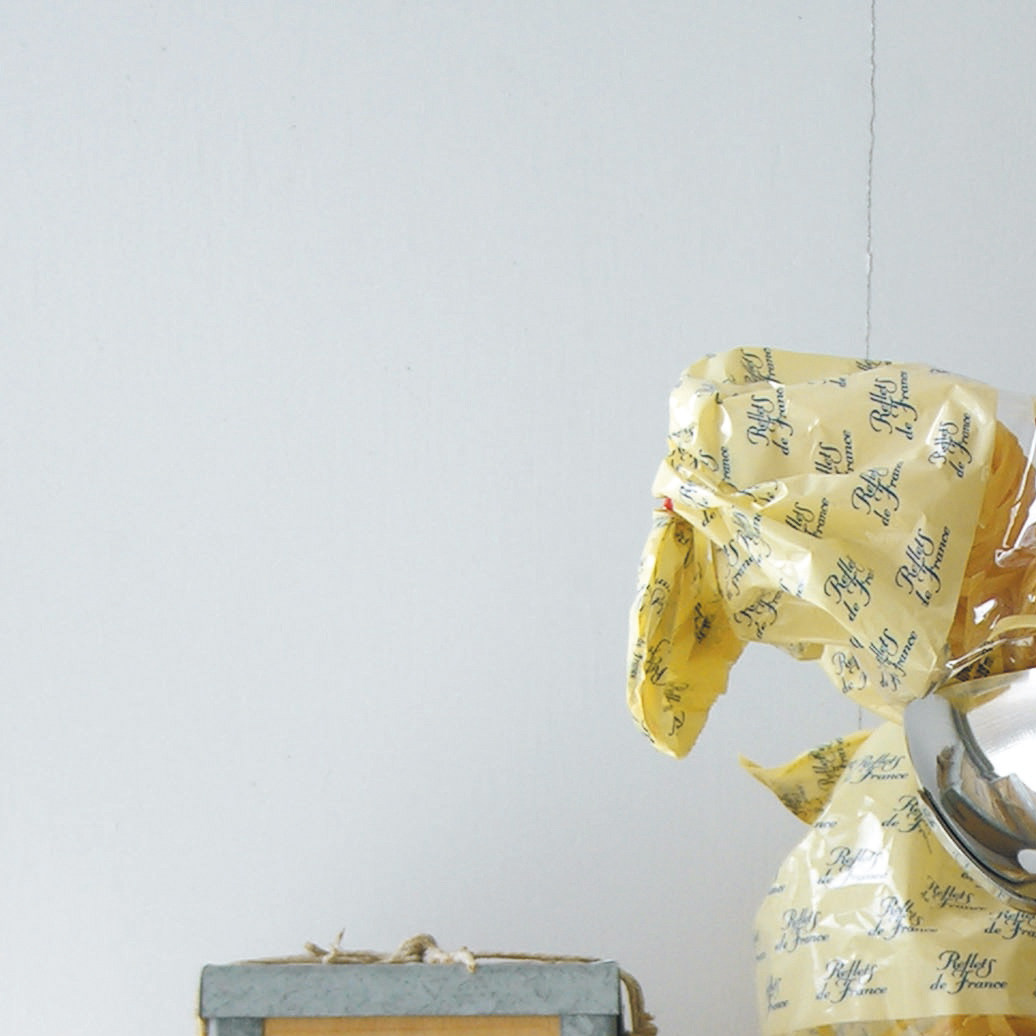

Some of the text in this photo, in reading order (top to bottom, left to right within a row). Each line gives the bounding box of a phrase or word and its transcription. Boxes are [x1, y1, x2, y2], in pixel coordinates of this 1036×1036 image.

[869, 377, 898, 434] Reflets
[895, 422, 914, 440] de
[771, 437, 790, 456] de
[948, 412, 973, 478] de France
[873, 508, 892, 527] de
[895, 528, 936, 595] Reflets
[918, 525, 951, 593] France
[843, 601, 860, 621] de
[850, 769, 909, 785] France
[868, 922, 885, 936] de
[984, 922, 1002, 935] de
[824, 958, 878, 984] Reflets
[936, 950, 998, 979] Reflets
[816, 981, 831, 1001] de
[830, 979, 888, 1004] France
[929, 971, 1009, 995] de France
